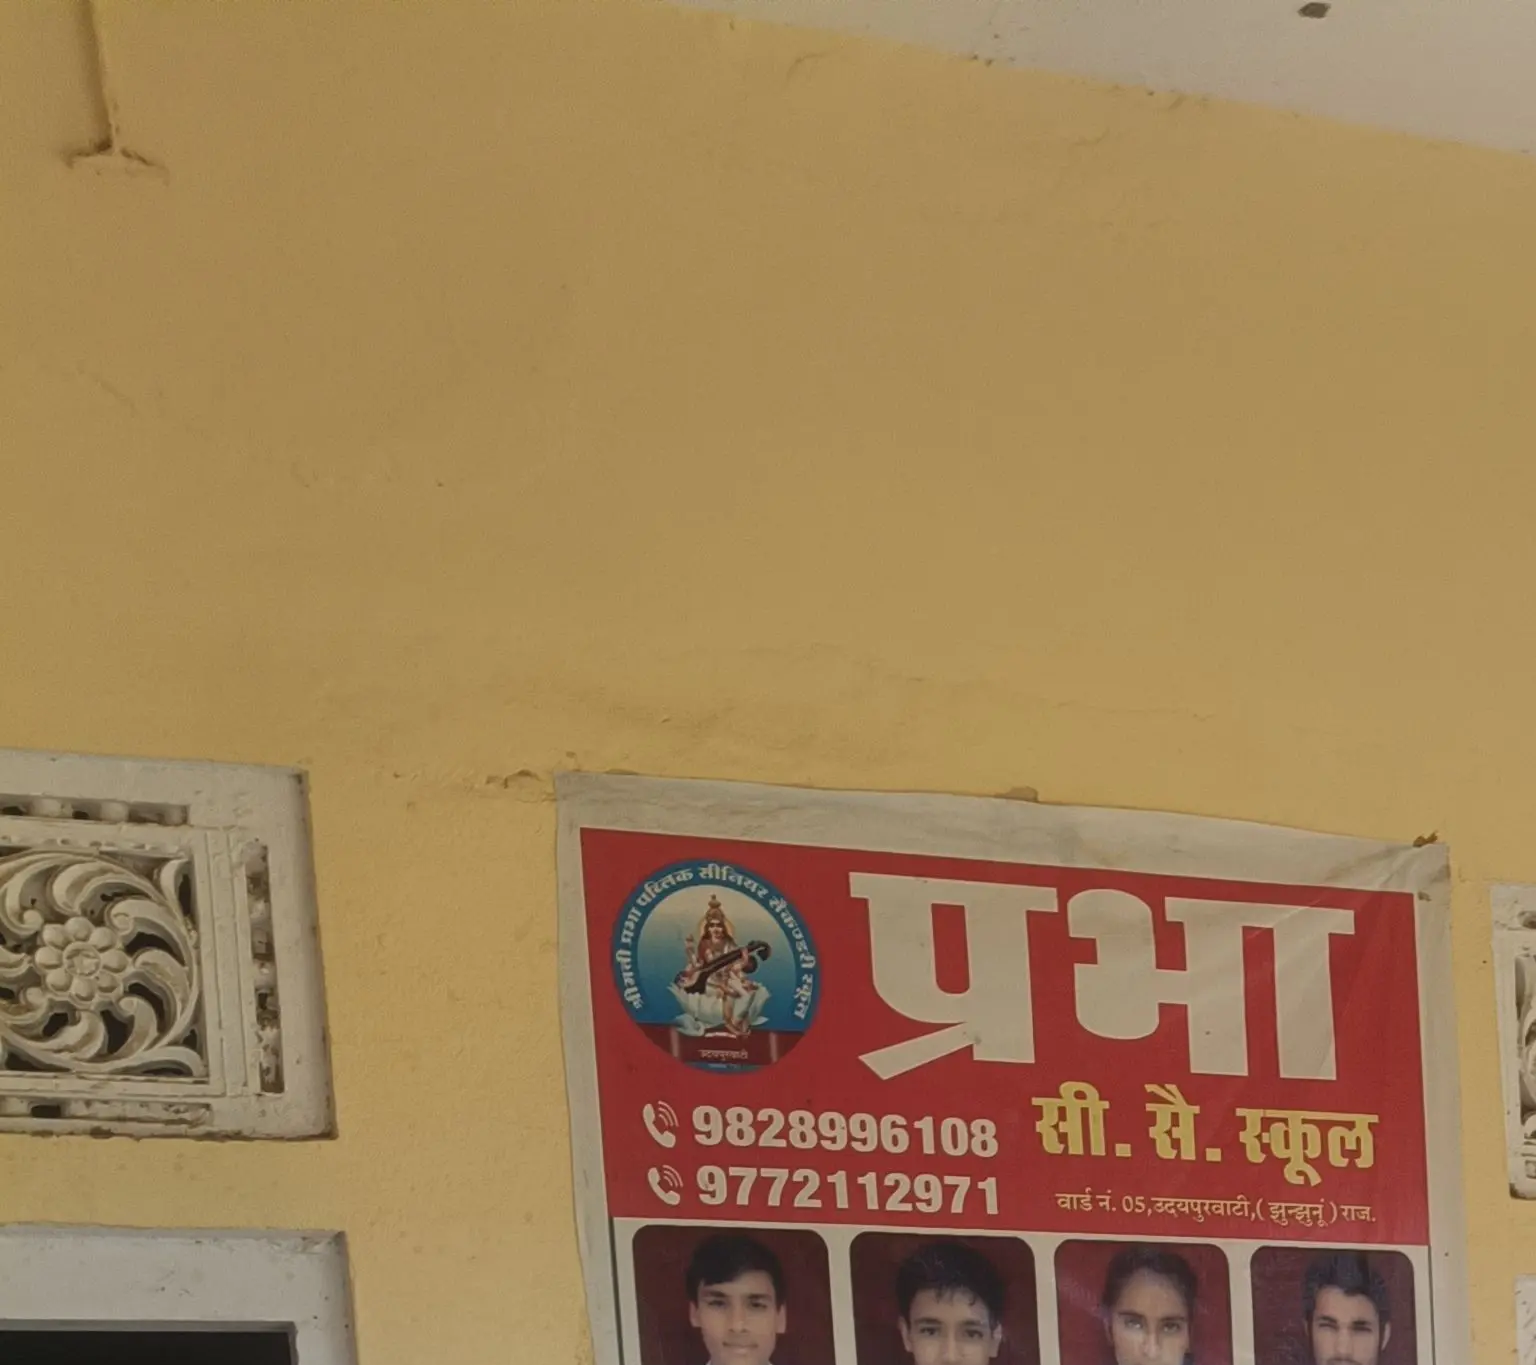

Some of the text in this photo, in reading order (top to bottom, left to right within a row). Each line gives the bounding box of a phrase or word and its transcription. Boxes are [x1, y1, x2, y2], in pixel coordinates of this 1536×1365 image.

[699, 863, 770, 898] सीनियर
[850, 871, 1355, 1081] प्रभा
[692, 1105, 999, 1158] 9828996108
[1235, 1107, 1379, 1186] स्कूल
[697, 1165, 999, 1216] 9772112971
[1056, 1188, 1093, 1211] वार्ड
